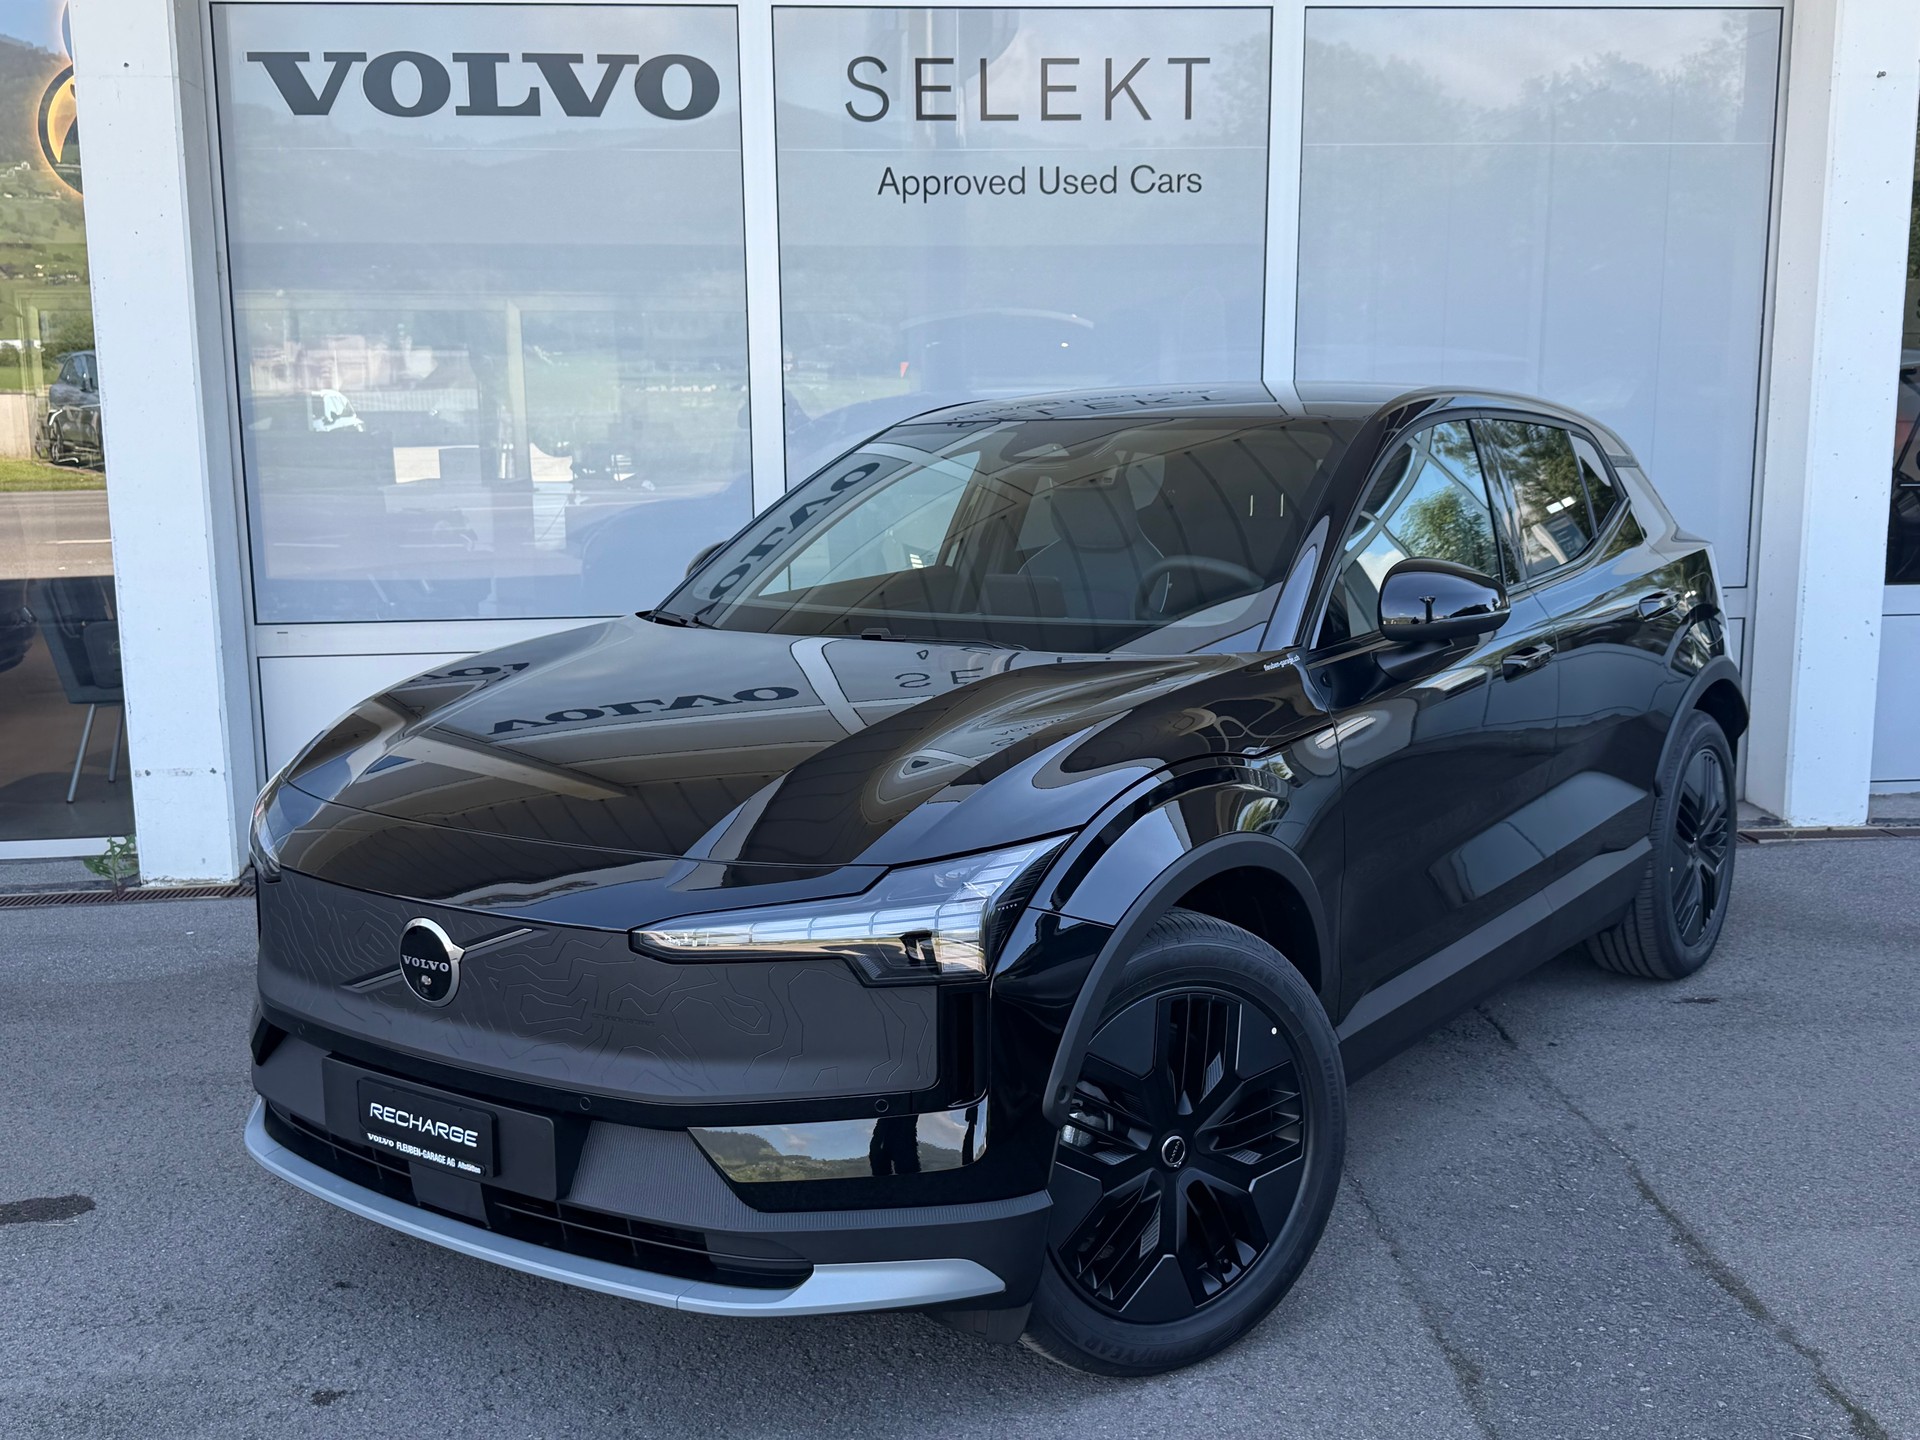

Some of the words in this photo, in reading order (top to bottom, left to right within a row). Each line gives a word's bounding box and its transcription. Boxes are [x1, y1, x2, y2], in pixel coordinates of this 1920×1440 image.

[246, 50, 721, 121] VOLVO
[845, 56, 1211, 122] SELEKT
[877, 166, 1026, 204] Approved
[1038, 165, 1118, 195] Used
[1130, 165, 1203, 194] Cars
[401, 954, 450, 973] VOLVO
[369, 1102, 479, 1148] RECHARGE
[367, 1132, 395, 1147] VOLVO
[446, 1157, 456, 1168] AG
